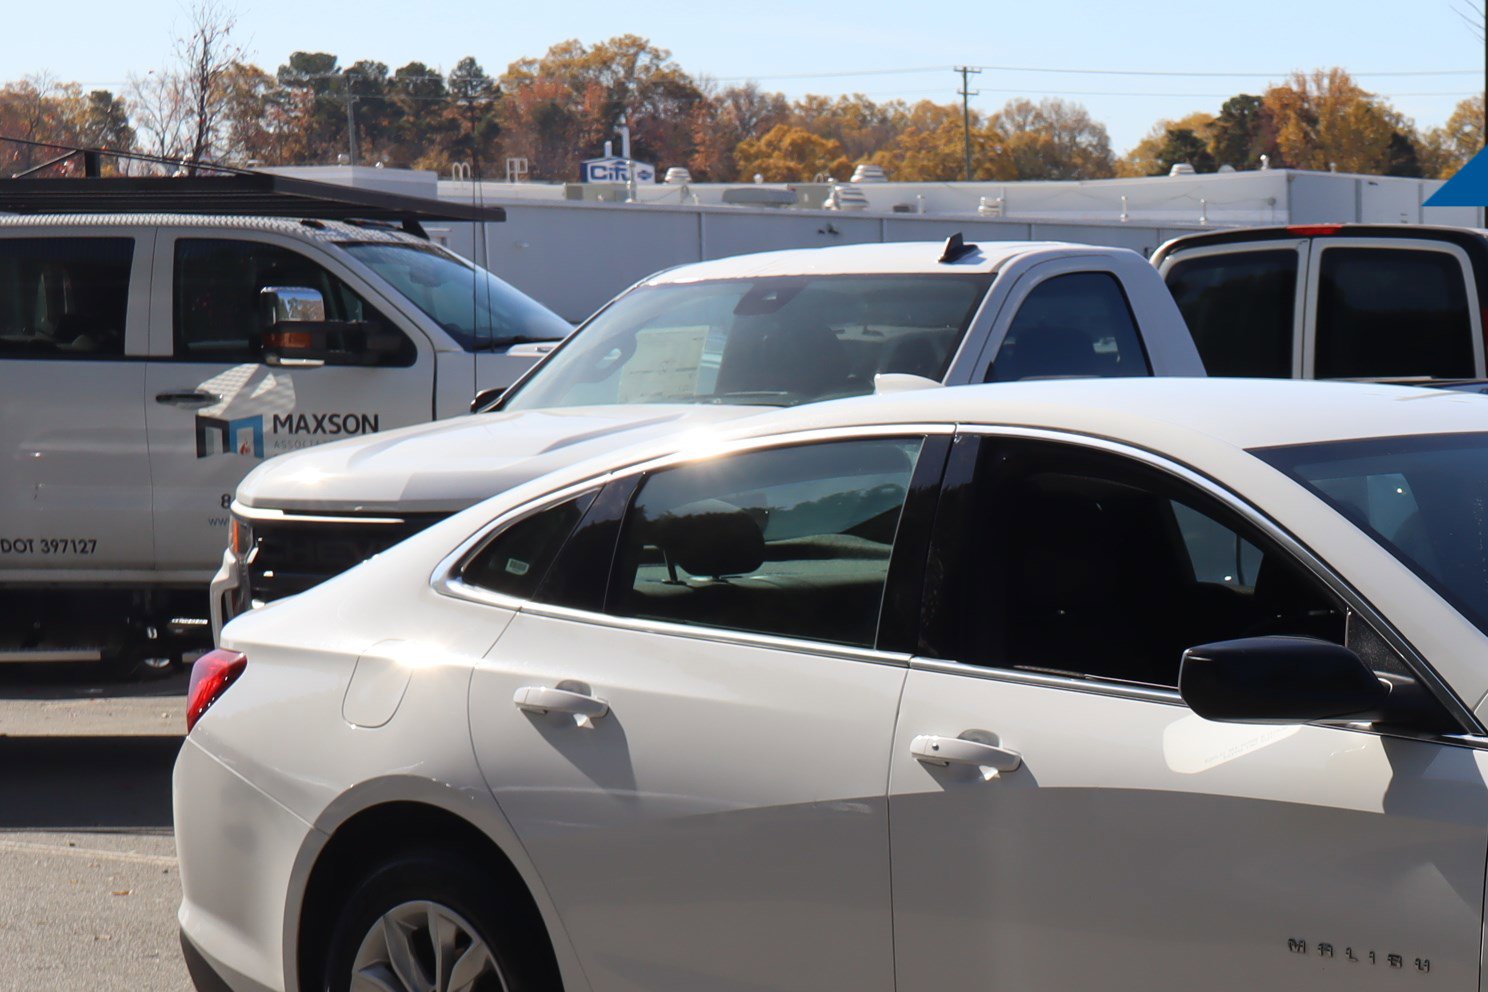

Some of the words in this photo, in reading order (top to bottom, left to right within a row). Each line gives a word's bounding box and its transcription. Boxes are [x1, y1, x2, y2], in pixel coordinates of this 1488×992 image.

[273, 414, 379, 434] MAXSON
[0, 539, 35, 554] DOT
[41, 539, 97, 554] 397127
[1288, 938, 1430, 973] MALIBU
